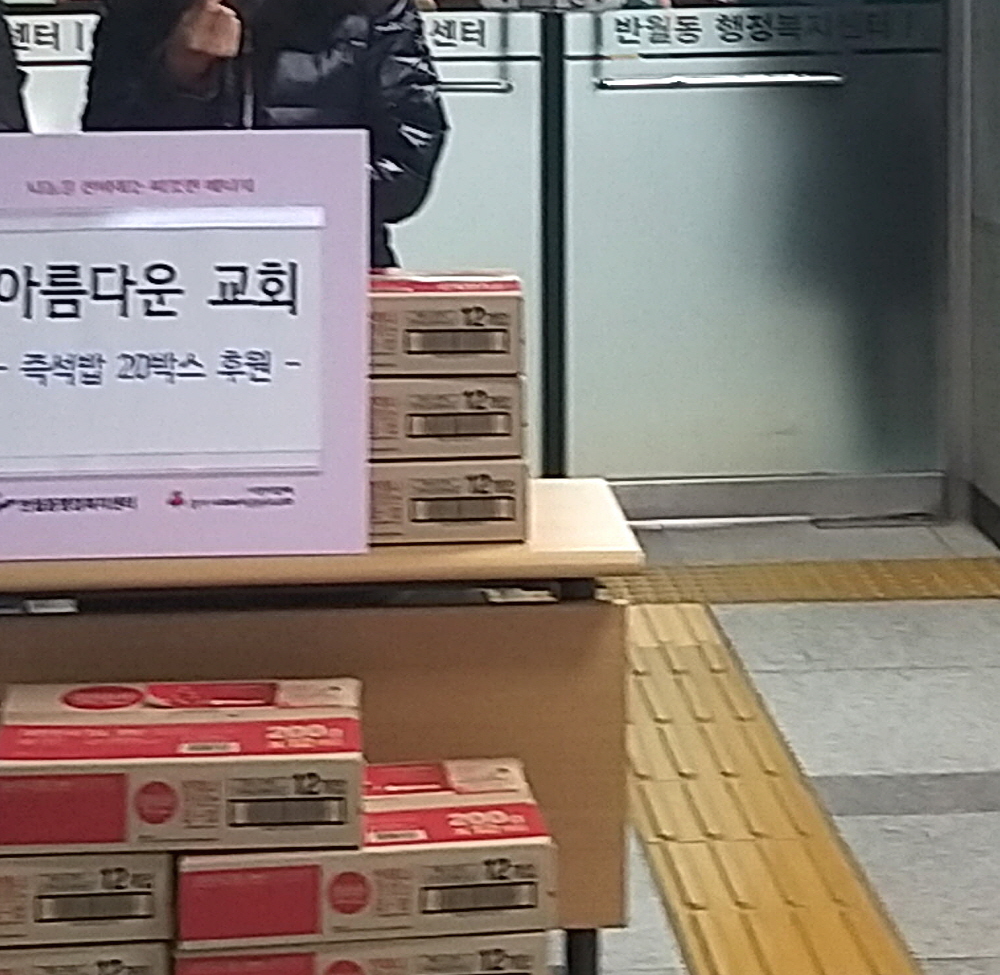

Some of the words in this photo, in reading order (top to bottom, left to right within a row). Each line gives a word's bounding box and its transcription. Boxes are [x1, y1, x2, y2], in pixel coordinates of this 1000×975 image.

[614, 15, 703, 45] 반월동
[207, 261, 298, 316] 교회
[19, 352, 105, 386] 즉석밥
[116, 351, 207, 384] 20박스
[216, 350, 272, 383] 후원
